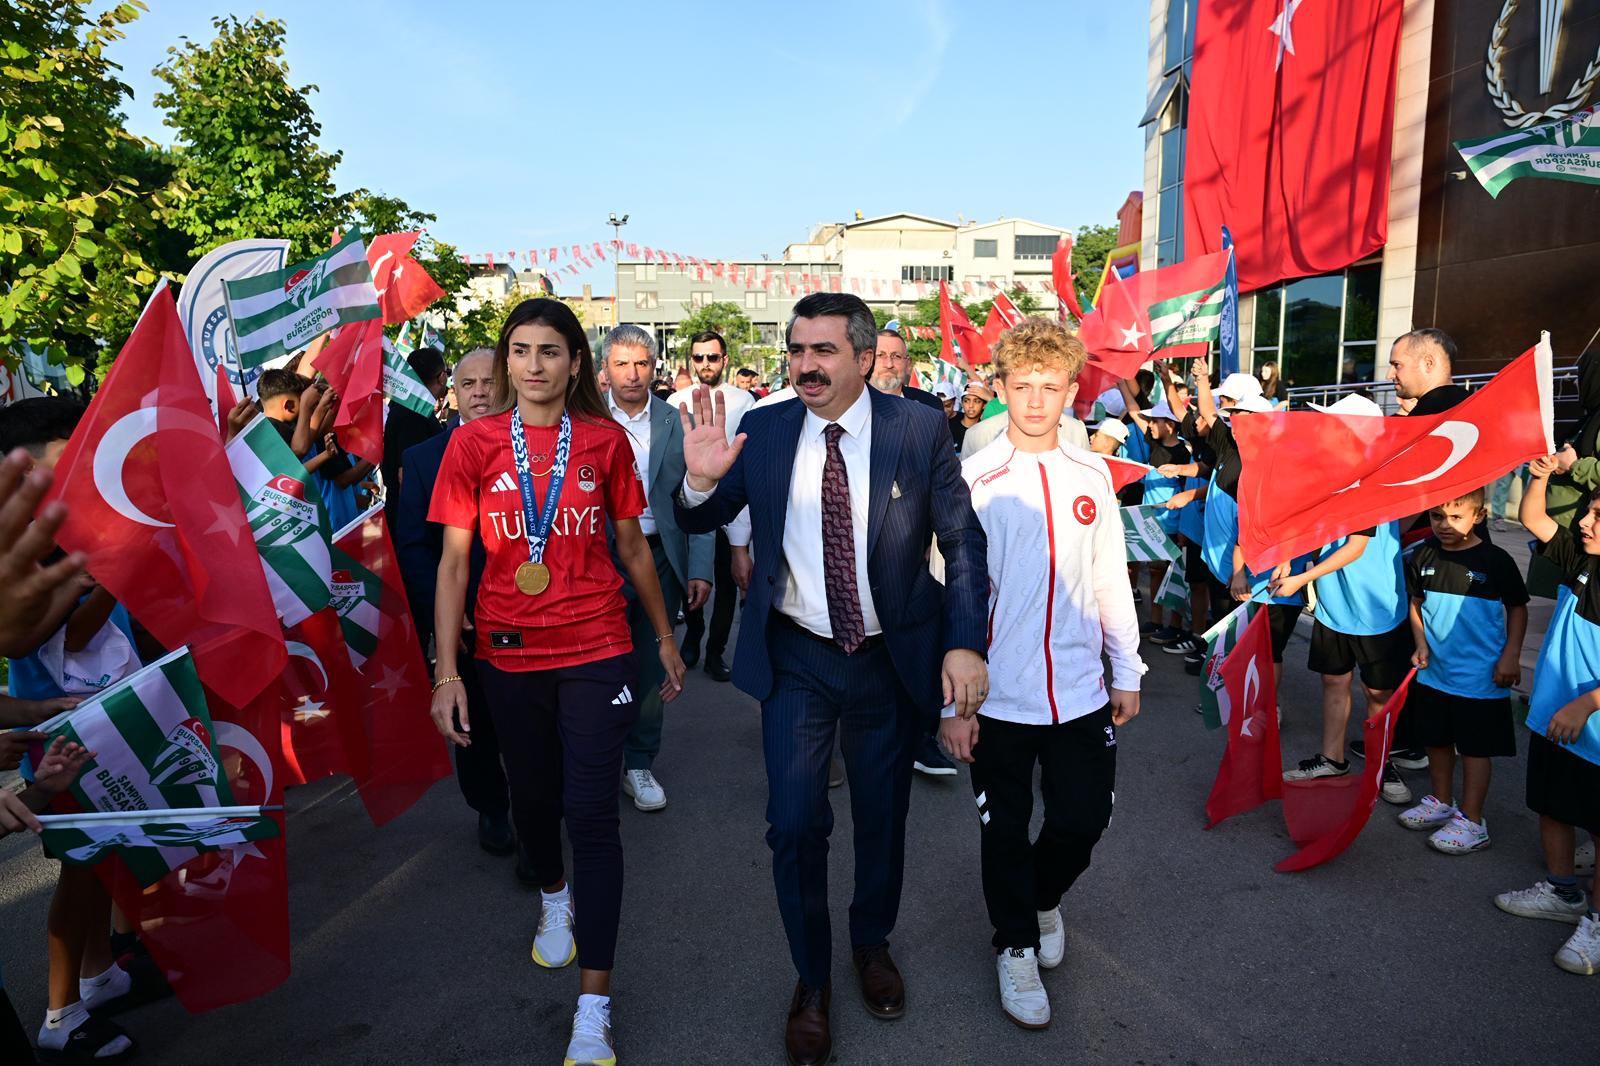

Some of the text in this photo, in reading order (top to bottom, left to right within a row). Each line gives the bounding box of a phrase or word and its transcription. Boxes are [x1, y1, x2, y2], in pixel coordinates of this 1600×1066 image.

[204, 311, 223, 347] BURSA
[286, 308, 333, 341] BURSASPOR
[981, 465, 1010, 486] hummel
[263, 489, 314, 515] BURSASPOR
[260, 513, 303, 536] 1963
[177, 728, 217, 770] BURSASPOR
[171, 752, 207, 779] 1963
